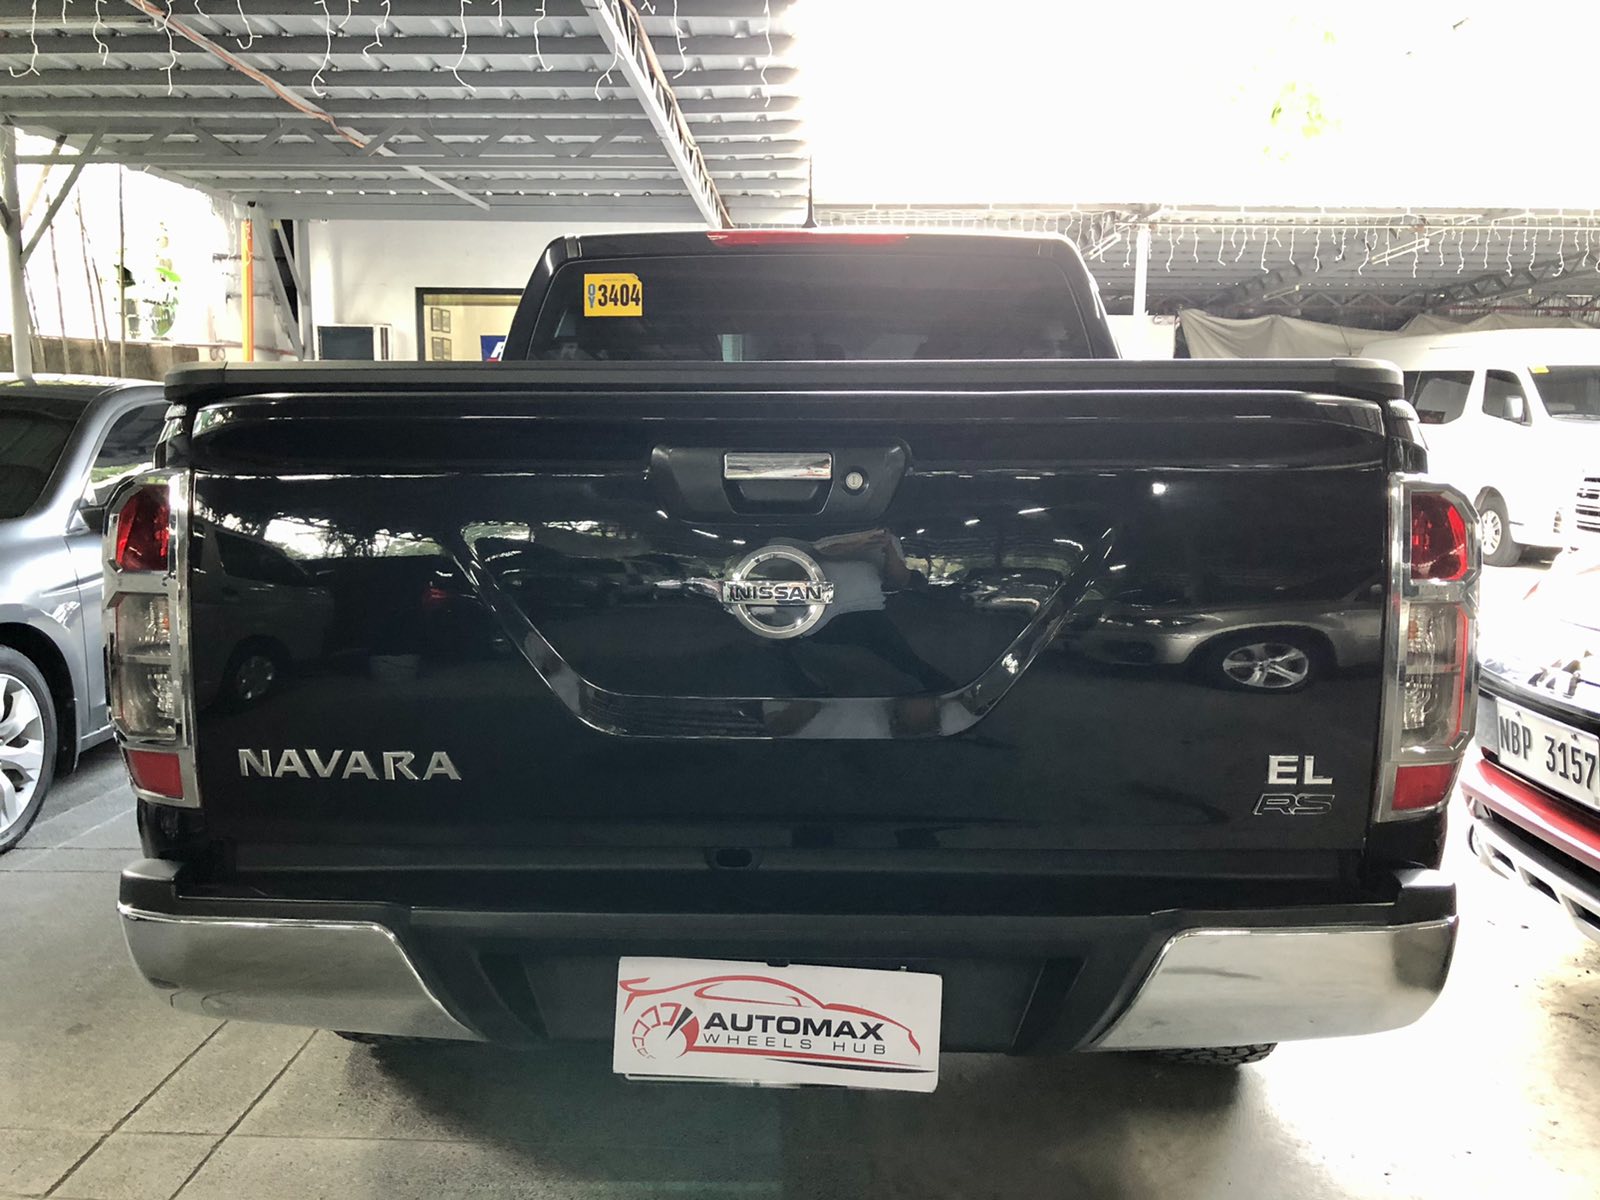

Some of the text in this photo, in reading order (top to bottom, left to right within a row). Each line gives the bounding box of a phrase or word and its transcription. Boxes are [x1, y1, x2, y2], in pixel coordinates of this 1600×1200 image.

[598, 283, 641, 307] 3404
[732, 585, 822, 601] NISSAN
[238, 748, 462, 781] NAVARA
[1499, 715, 1597, 790] NBP 3157
[1268, 754, 1334, 785] EL
[1253, 792, 1336, 816] RS
[704, 1012, 884, 1041] AUTOMAX
[703, 1033, 886, 1055] WHEELS HUB
